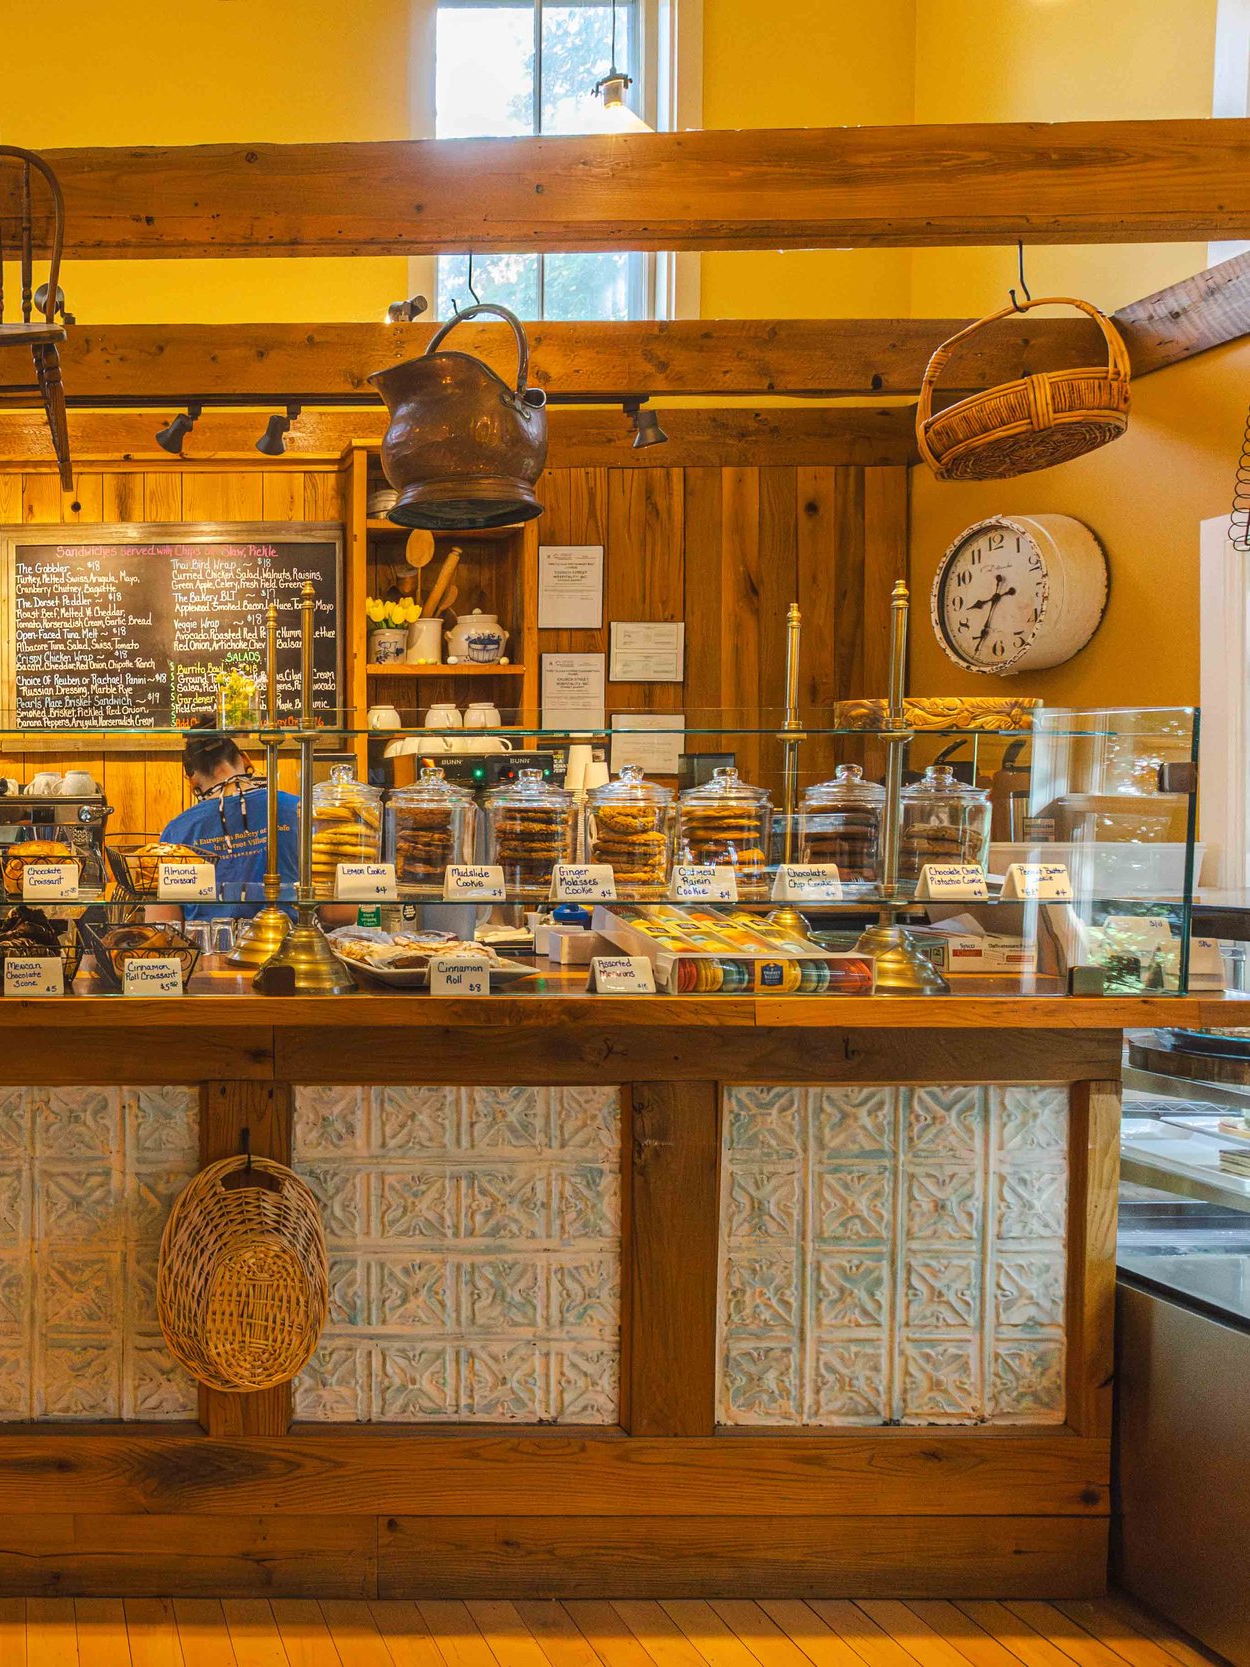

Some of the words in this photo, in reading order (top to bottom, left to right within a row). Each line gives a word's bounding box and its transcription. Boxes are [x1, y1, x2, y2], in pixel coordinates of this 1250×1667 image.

[987, 533, 1004, 551] 12
[971, 548, 981, 565] 11
[16, 564, 33, 574] The
[957, 570, 973, 587] 10
[952, 596, 964, 611] 9
[174, 619, 197, 633] Veggie
[957, 617, 970, 634] 8
[992, 640, 1005, 656] 6
[226, 652, 260, 662] SALADS
[126, 674, 146, 685] Panini
[27, 867, 62, 875] Chocolate
[164, 866, 197, 875] Almond
[451, 868, 490, 878] Mudslide
[559, 866, 589, 879] Ginger
[788, 868, 827, 877] Chocolate
[929, 866, 962, 876] Chocolate
[29, 875, 64, 886] Croissant
[163, 876, 198, 886] Croissant
[559, 877, 598, 886] Molasses
[375, 886, 387, 894] $4
[565, 886, 593, 895] Cookie
[601, 889, 612, 898] $4
[676, 886, 708, 896] Cookie
[127, 961, 170, 972] Cinnamon
[437, 961, 483, 973] Cinnamon
[597, 958, 632, 968] Assorted
[6, 971, 42, 980] Chocolate
[125, 972, 140, 981] Roll
[141, 971, 178, 981] Croissant
[446, 974, 462, 984] Roll
[13, 980, 38, 988] Scone
[45, 985, 57, 993] $5
[468, 983, 482, 992] $8
